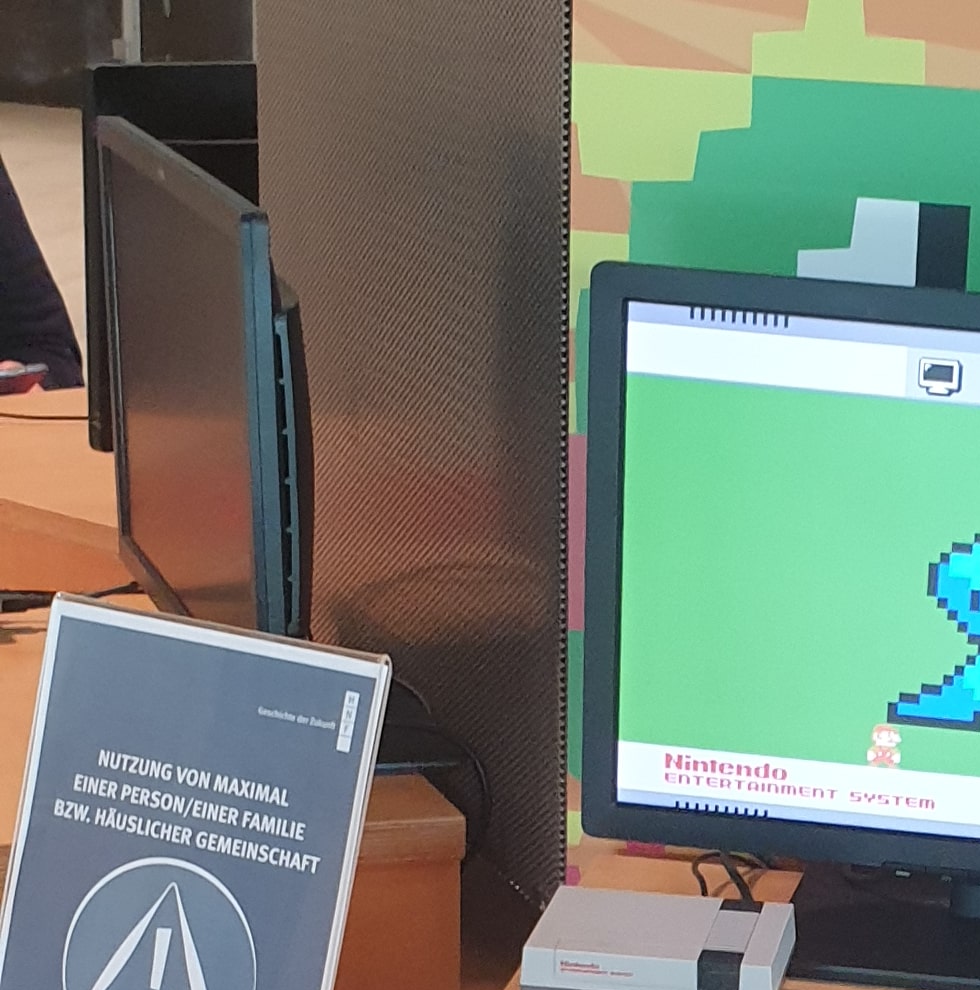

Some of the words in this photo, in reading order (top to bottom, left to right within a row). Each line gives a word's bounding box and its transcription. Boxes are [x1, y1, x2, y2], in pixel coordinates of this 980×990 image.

[98, 749, 173, 782] NUTZUNG
[176, 765, 212, 790] VON
[213, 773, 290, 808] MAXIMAL
[664, 753, 788, 782] Nintendo
[664, 772, 839, 800] ENTERTAINMENT
[850, 791, 936, 811] SYSTEM
[53, 798, 92, 824] BZW.
[94, 806, 193, 847] HÄUSLICHER
[196, 831, 321, 874] GEMEINSCHAFT
[73, 773, 118, 800] EINER
[120, 783, 239, 827] PERSON/EINER
[242, 809, 306, 841] FAMILIE
